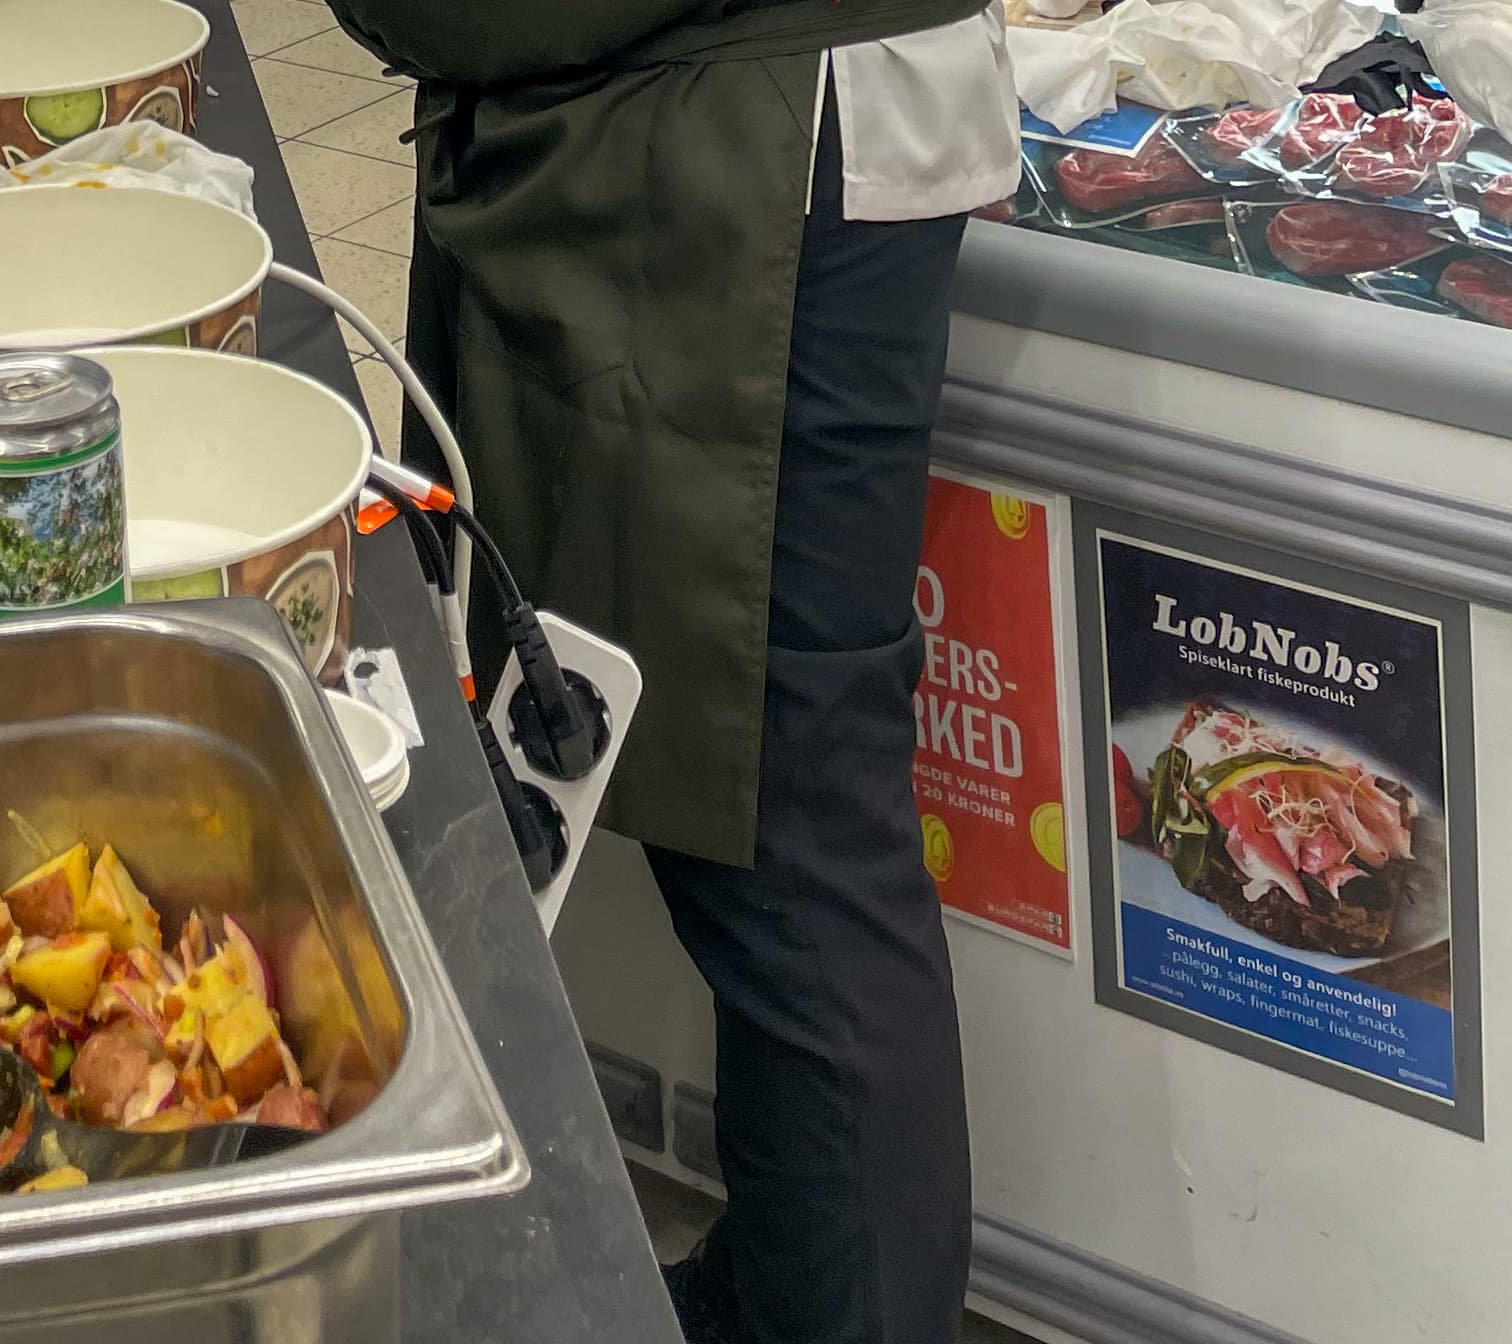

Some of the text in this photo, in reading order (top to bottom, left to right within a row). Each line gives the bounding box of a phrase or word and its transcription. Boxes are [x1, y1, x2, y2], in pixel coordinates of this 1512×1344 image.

[1178, 645, 1356, 708] Spiseklart fiskeprodukt
[922, 784, 942, 801] 20
[948, 792, 1016, 827] KRONER
[956, 775, 1010, 806] VARER
[1166, 928, 1397, 1017] Smakfull, enkel og anvendelig!
[1227, 970, 1276, 997] salater,
[1200, 980, 1246, 1007] wraps,
